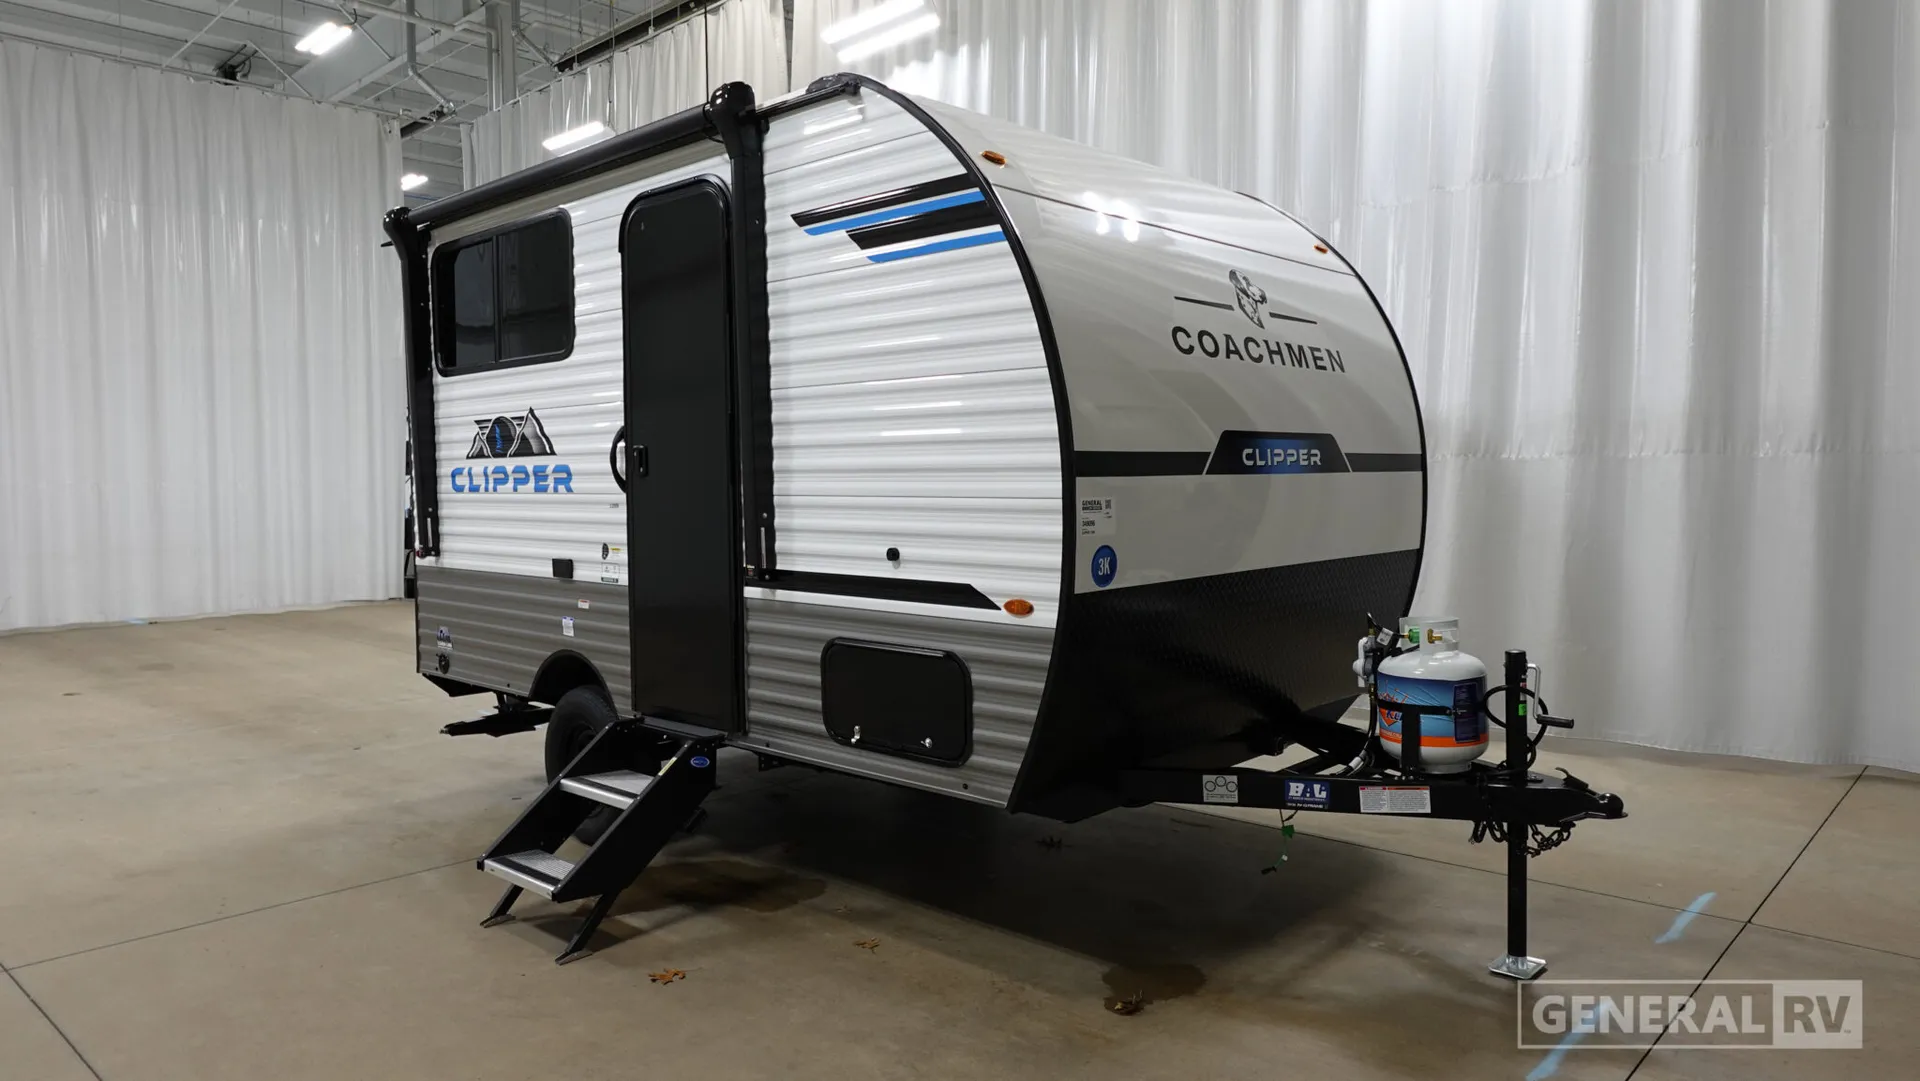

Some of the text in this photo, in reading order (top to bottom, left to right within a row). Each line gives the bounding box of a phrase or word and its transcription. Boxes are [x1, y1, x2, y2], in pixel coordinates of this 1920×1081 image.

[1171, 326, 1346, 373] COACHMEN
[1242, 448, 1321, 466] CLIPPER
[451, 464, 574, 493] CLIPPER
[1098, 556, 1111, 576] 3K
